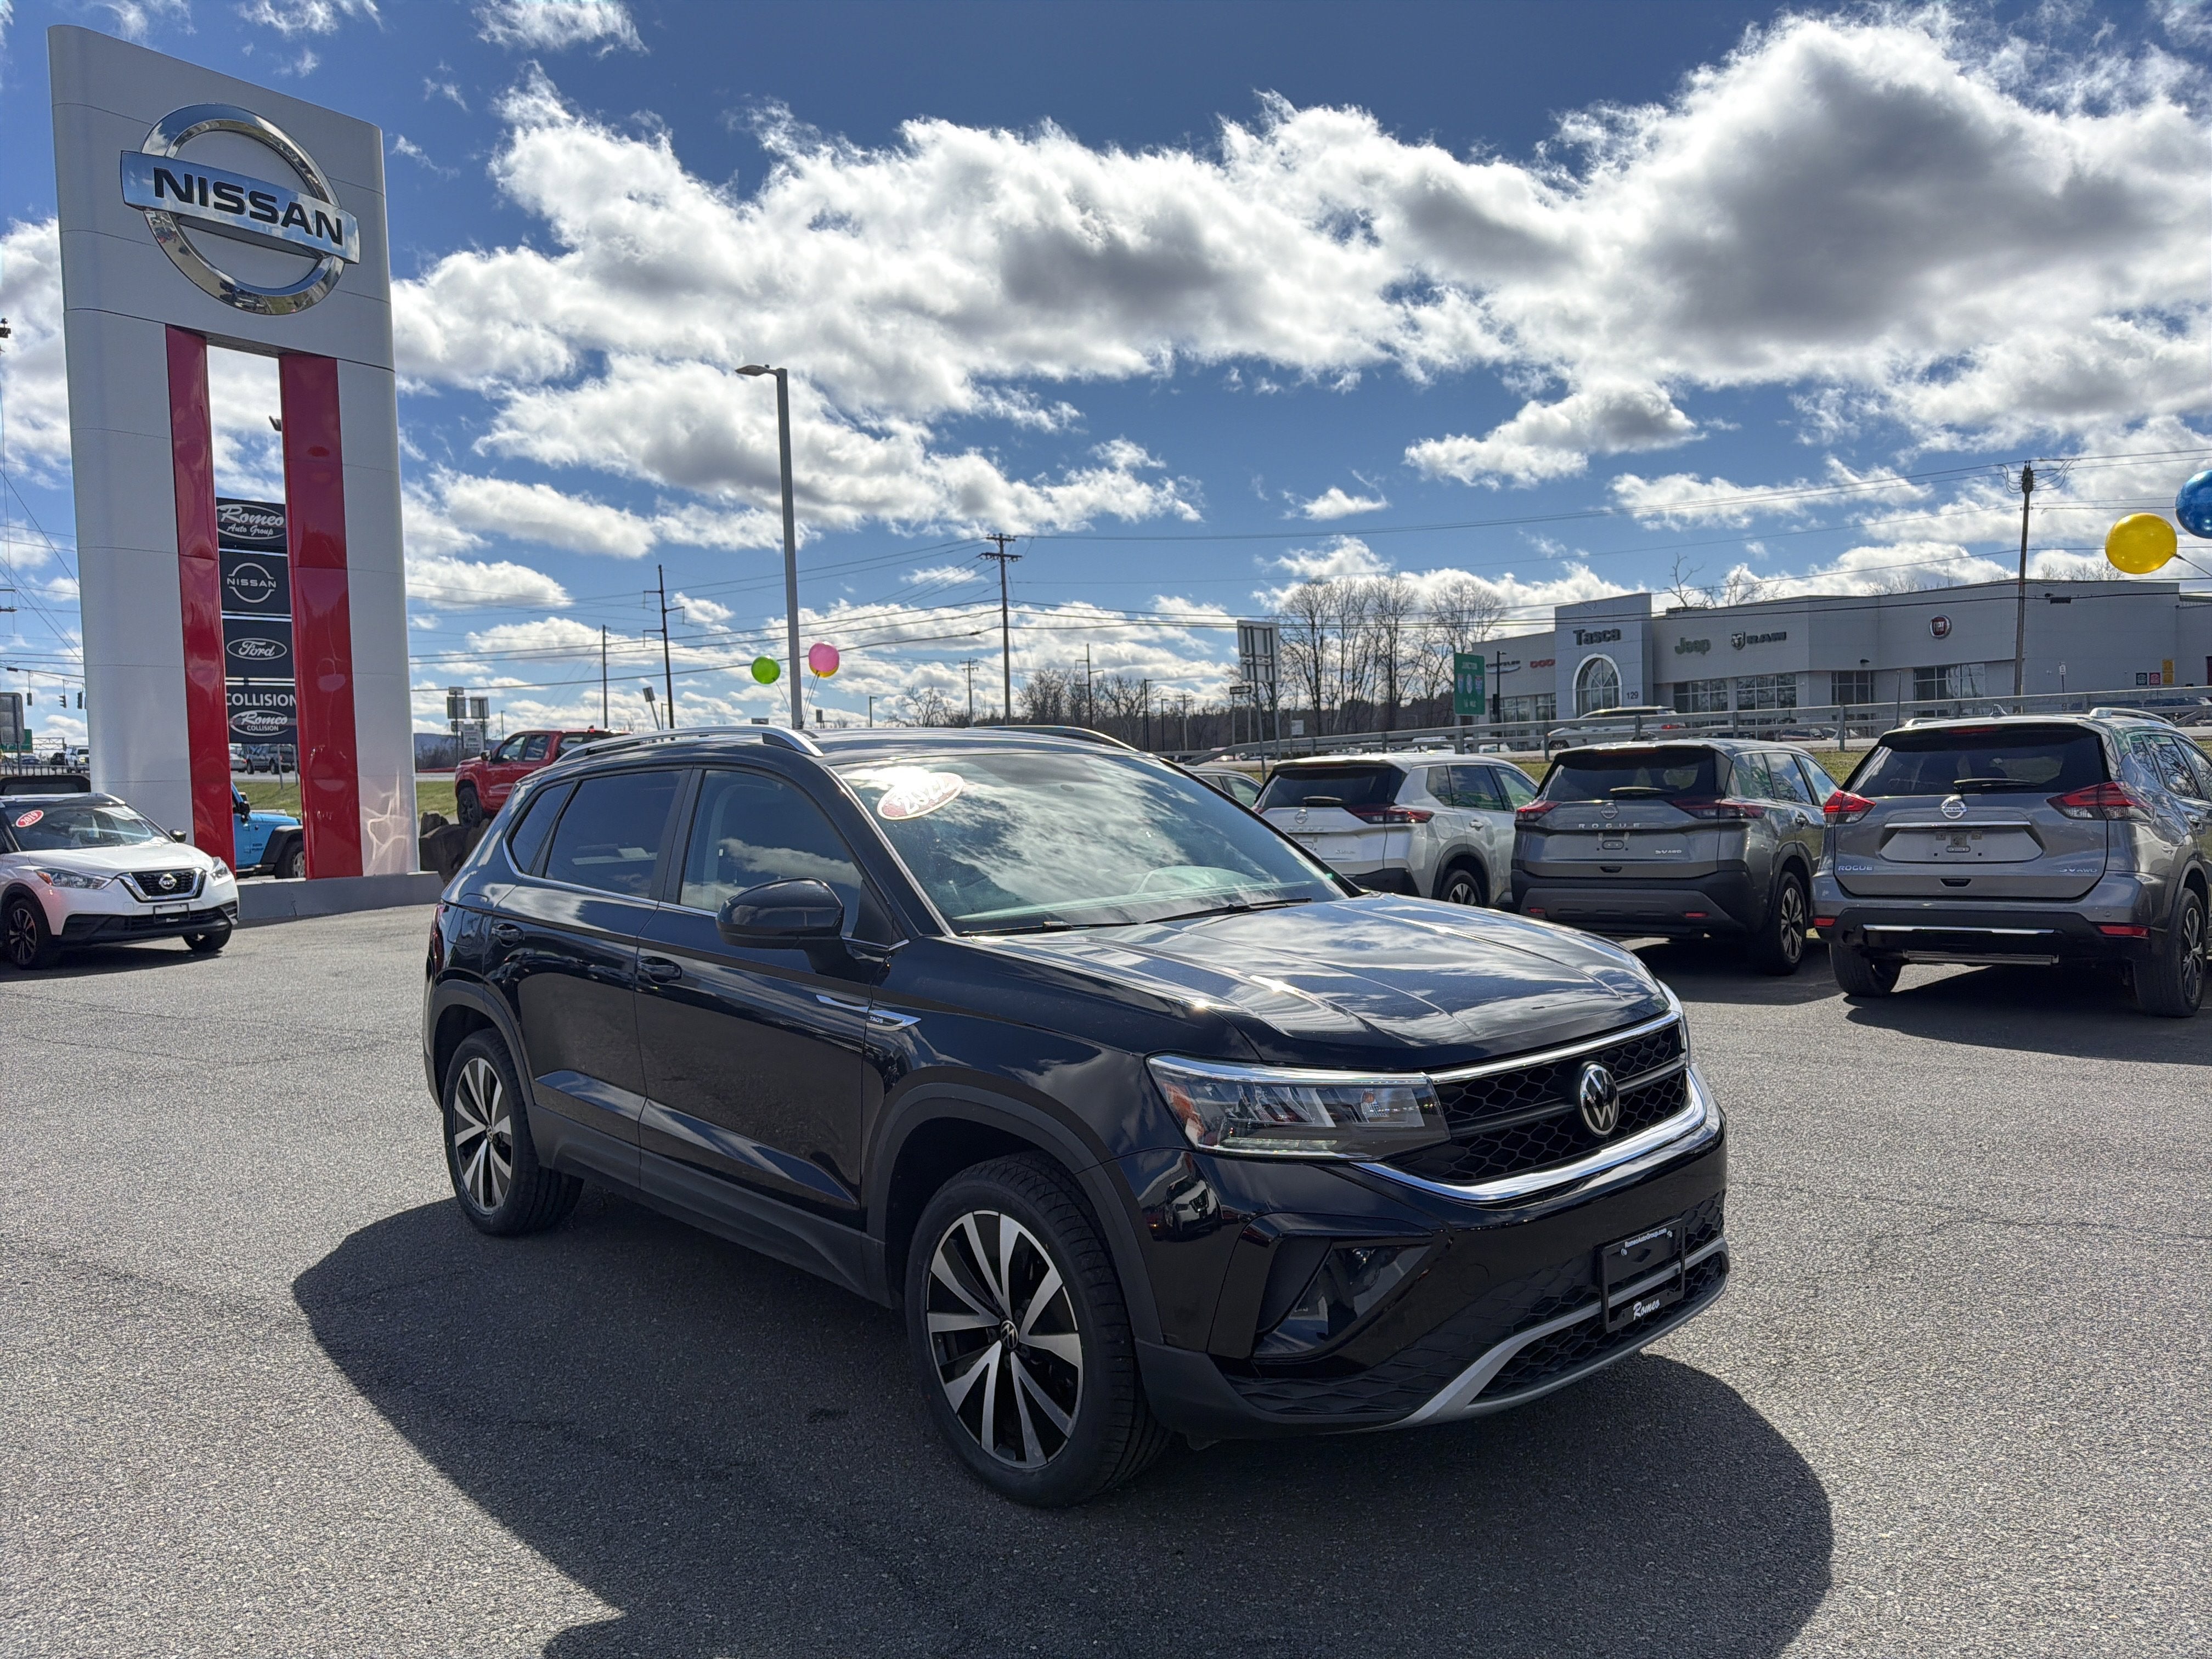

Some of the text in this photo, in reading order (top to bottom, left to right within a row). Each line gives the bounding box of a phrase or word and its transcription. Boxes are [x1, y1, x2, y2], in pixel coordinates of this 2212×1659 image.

[154, 167, 343, 246] NISSAN
[219, 504, 284, 526] Romeo
[227, 523, 273, 537] Auto Group
[227, 578, 276, 588] NISSAN
[1572, 629, 1621, 646] Tasca
[1747, 631, 1787, 645] RAM
[239, 640, 275, 657] Ford
[1674, 637, 1712, 655] Jeep
[1530, 659, 1555, 668] DOD
[226, 693, 296, 707] COLLISION
[1627, 691, 1639, 699] 129
[240, 711, 287, 725] Romeo
[20, 812, 38, 826] 2019
[1624, 1228, 1667, 1249] RomeoAutoGroup.com
[1633, 1299, 1660, 1321] Romeo
